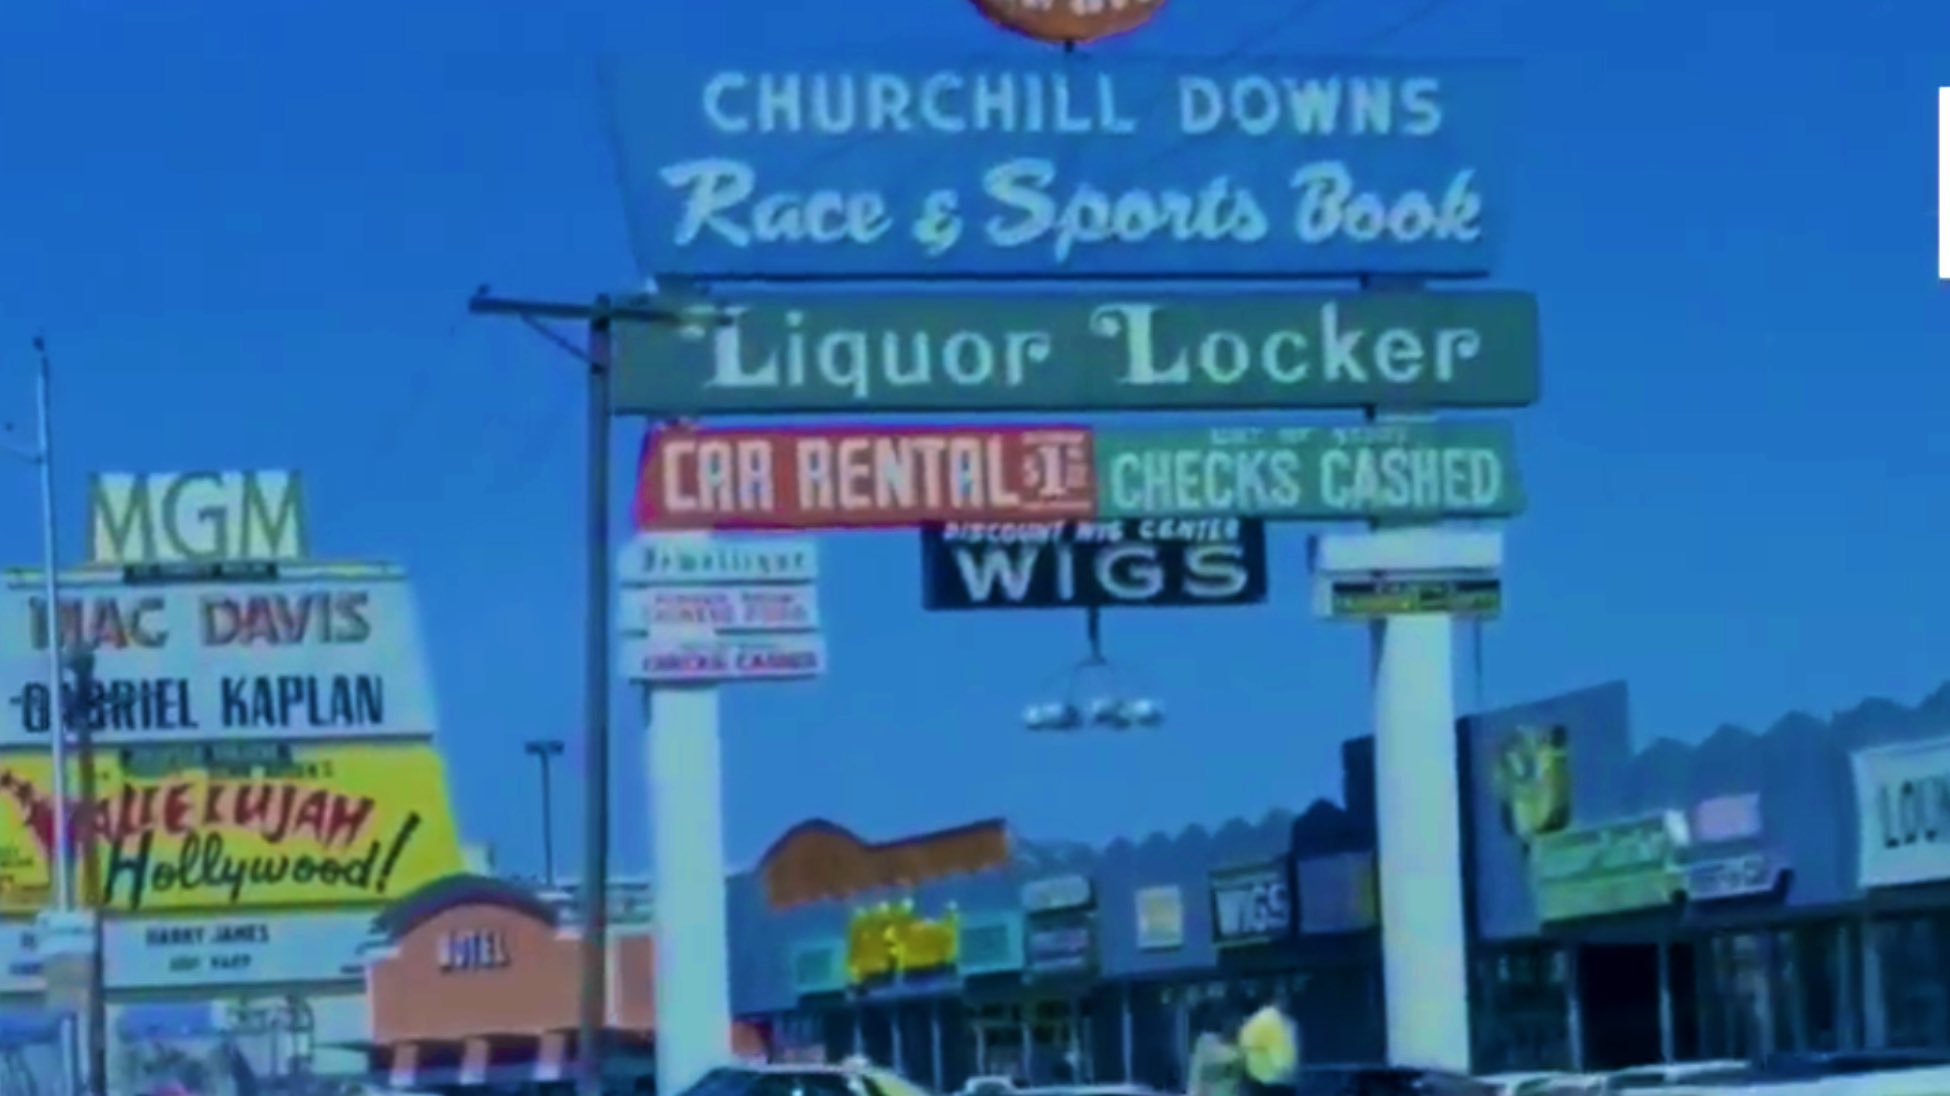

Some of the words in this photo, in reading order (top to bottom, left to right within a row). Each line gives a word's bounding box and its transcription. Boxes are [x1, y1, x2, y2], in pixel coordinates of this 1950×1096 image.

[704, 71, 1137, 136] CHURCHILL
[1180, 73, 1444, 136] DOWNS
[661, 159, 892, 246] Race
[912, 190, 965, 255] &
[983, 158, 1269, 261] Sports
[1291, 160, 1482, 244] Book
[686, 304, 1053, 396] Liquor
[1090, 300, 1480, 384] Locker
[663, 439, 772, 511] CAR
[796, 435, 1019, 509] RENTAL
[1111, 450, 1300, 510] CHECKS
[1320, 449, 1500, 509] CASHED
[88, 470, 308, 560] MGM
[944, 520, 1066, 542] DISCOUNT
[1138, 518, 1240, 541] CENTER
[956, 544, 1248, 600] WIGS
[29, 596, 169, 650] MAC
[205, 591, 372, 646] DAVIS
[221, 674, 384, 728] KAPLAN
[103, 811, 421, 910] Hollywood!
[145, 926, 204, 948] HARRY
[210, 923, 269, 945] JAMES
